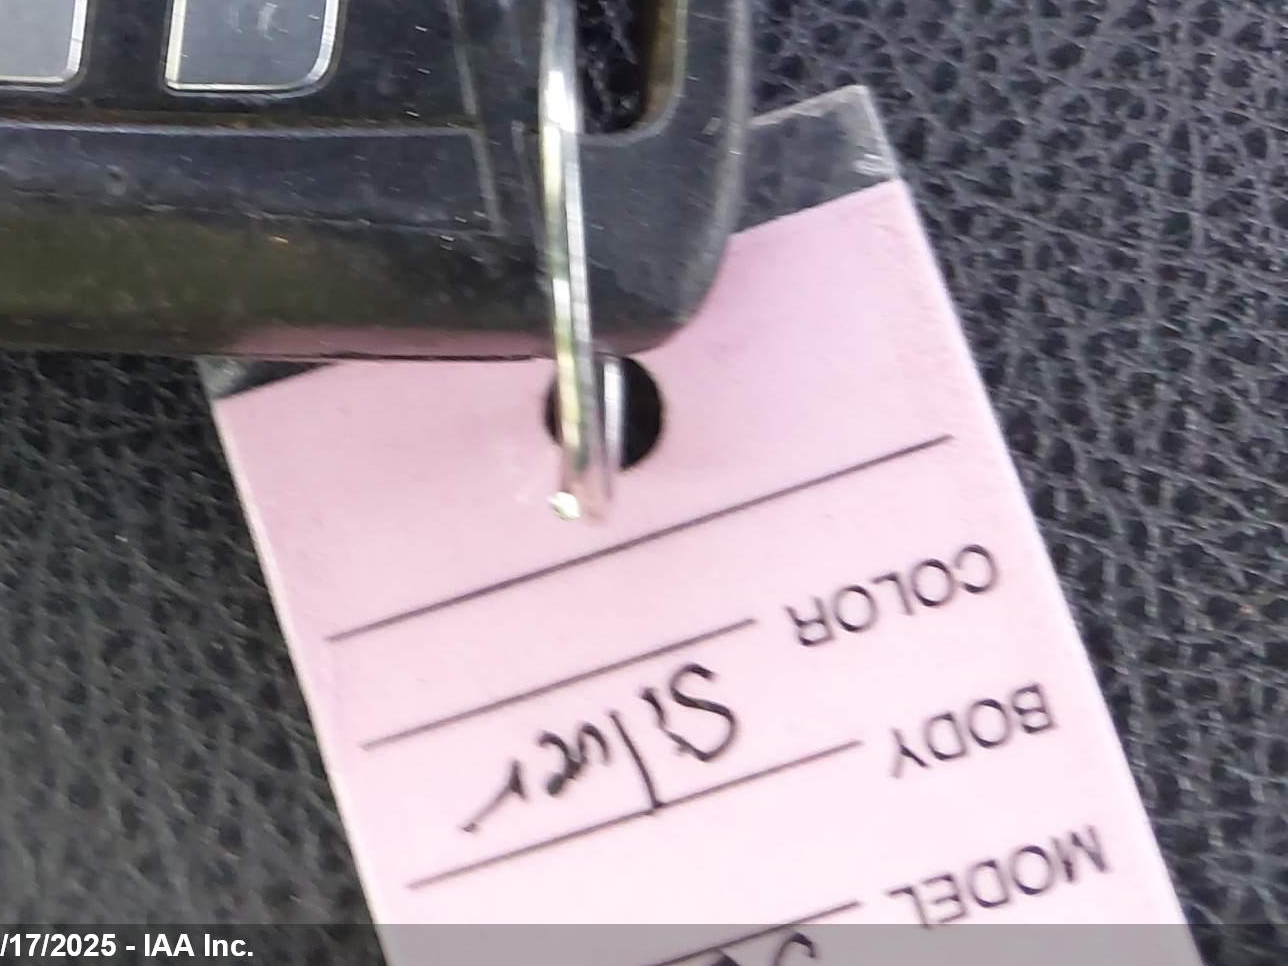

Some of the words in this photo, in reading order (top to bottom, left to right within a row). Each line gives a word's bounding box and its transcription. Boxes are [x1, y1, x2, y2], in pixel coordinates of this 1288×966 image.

[786, 543, 999, 647] COLOR
[889, 684, 1058, 777] BODY
[887, 824, 1111, 930] MODEL
